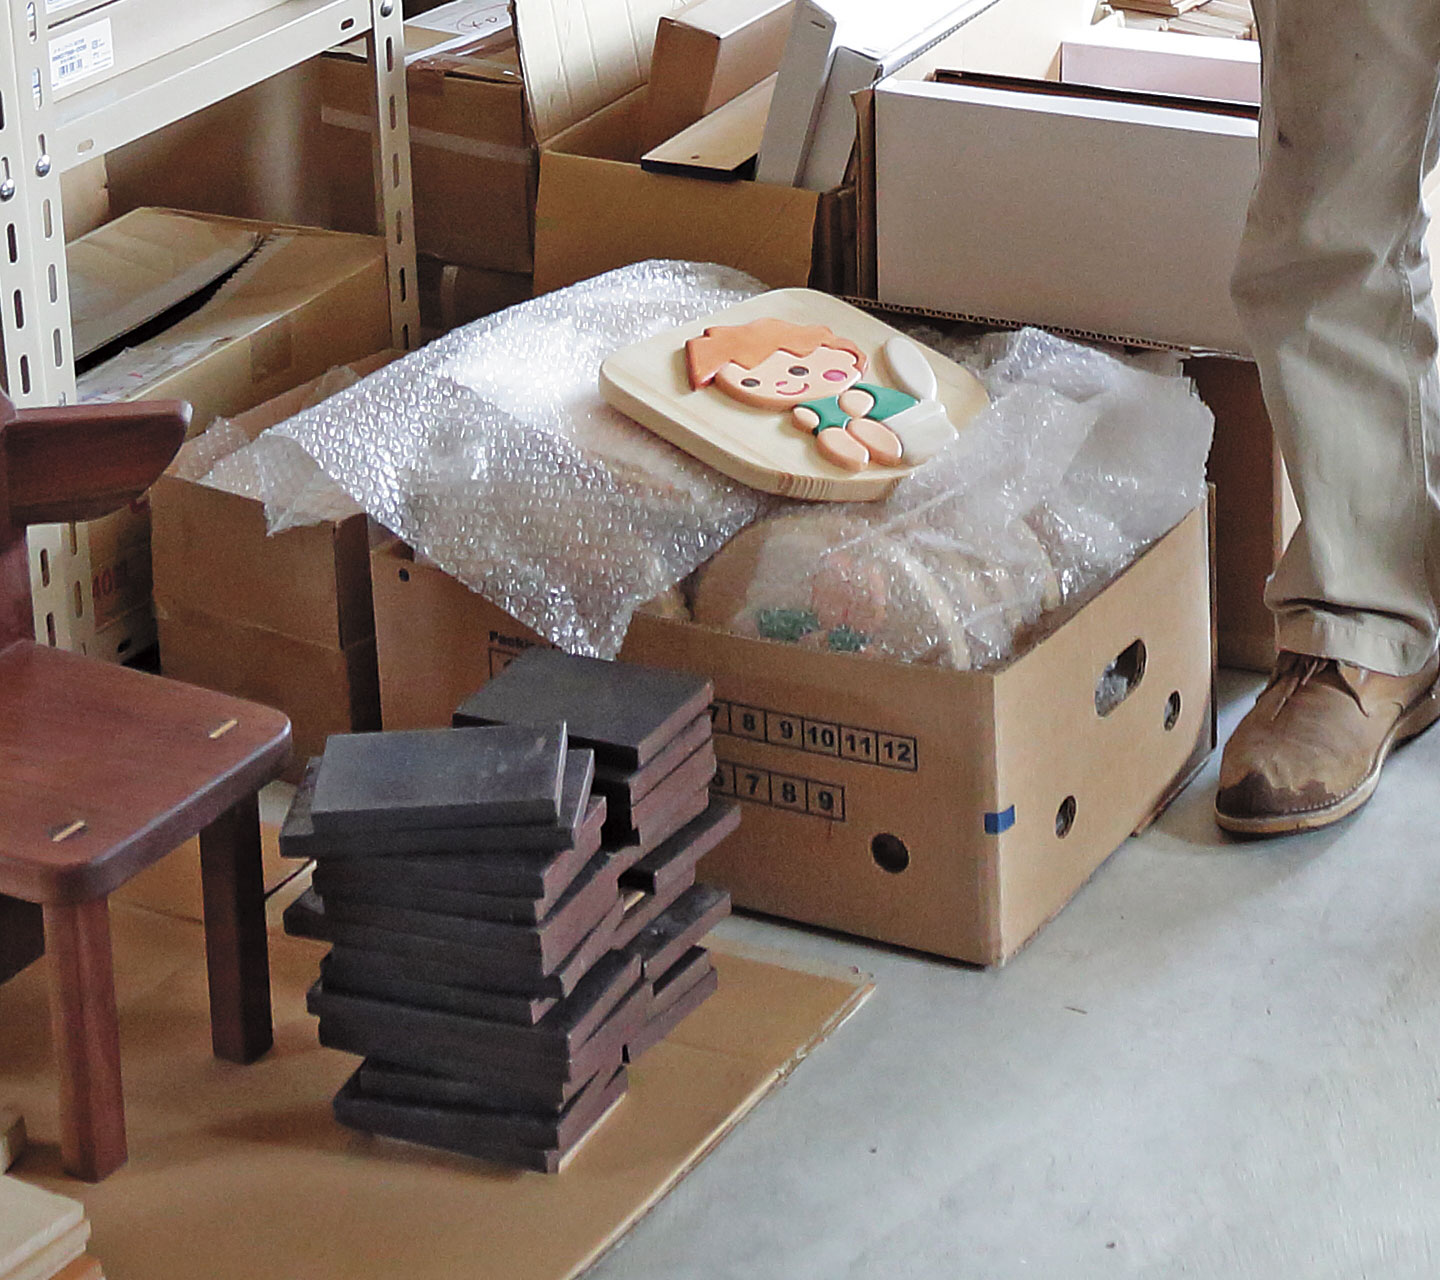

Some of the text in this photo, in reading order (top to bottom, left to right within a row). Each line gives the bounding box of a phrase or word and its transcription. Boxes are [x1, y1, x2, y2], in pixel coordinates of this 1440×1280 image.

[743, 713, 756, 733] 8
[779, 720, 793, 740] 9
[808, 726, 834, 748] 10
[846, 734, 871, 756] 11
[883, 741, 911, 763] 12
[745, 773, 760, 796] 7
[782, 782, 797, 804] 8
[818, 791, 834, 811] 9
